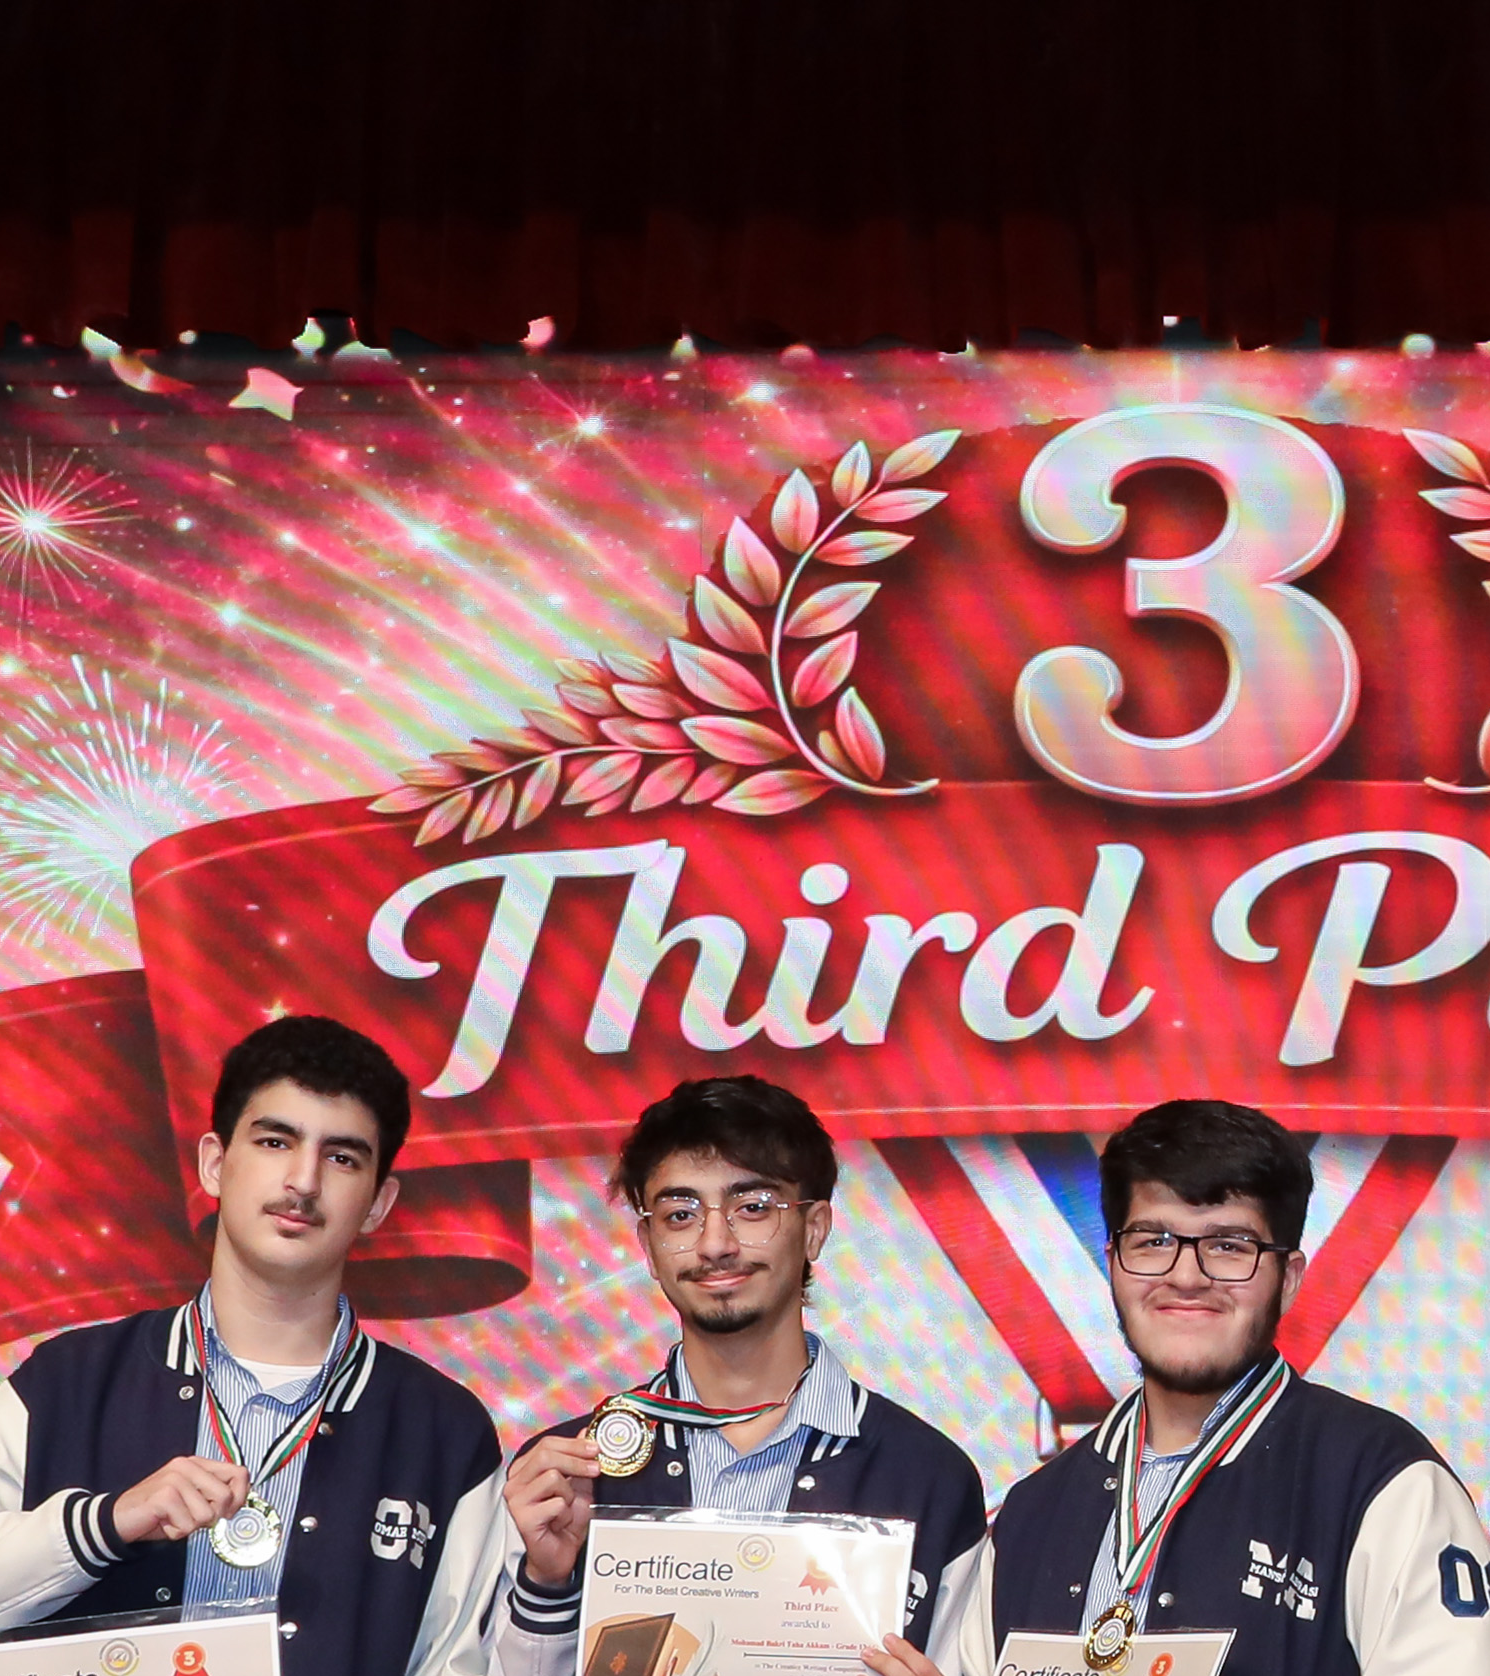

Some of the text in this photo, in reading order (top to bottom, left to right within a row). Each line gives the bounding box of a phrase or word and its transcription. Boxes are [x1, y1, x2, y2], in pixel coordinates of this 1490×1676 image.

[1013, 401, 1356, 806] 3
[366, 839, 1154, 1096] Third
[374, 1522, 408, 1538] OMAR
[593, 1553, 734, 1582] Certificate
[614, 1584, 759, 1600] For The Best Creative Writers
[784, 1601, 838, 1612] Third Place
[781, 1620, 830, 1629] awarded to
[183, 1651, 195, 1666] 3
[1155, 1660, 1166, 1676] 3
